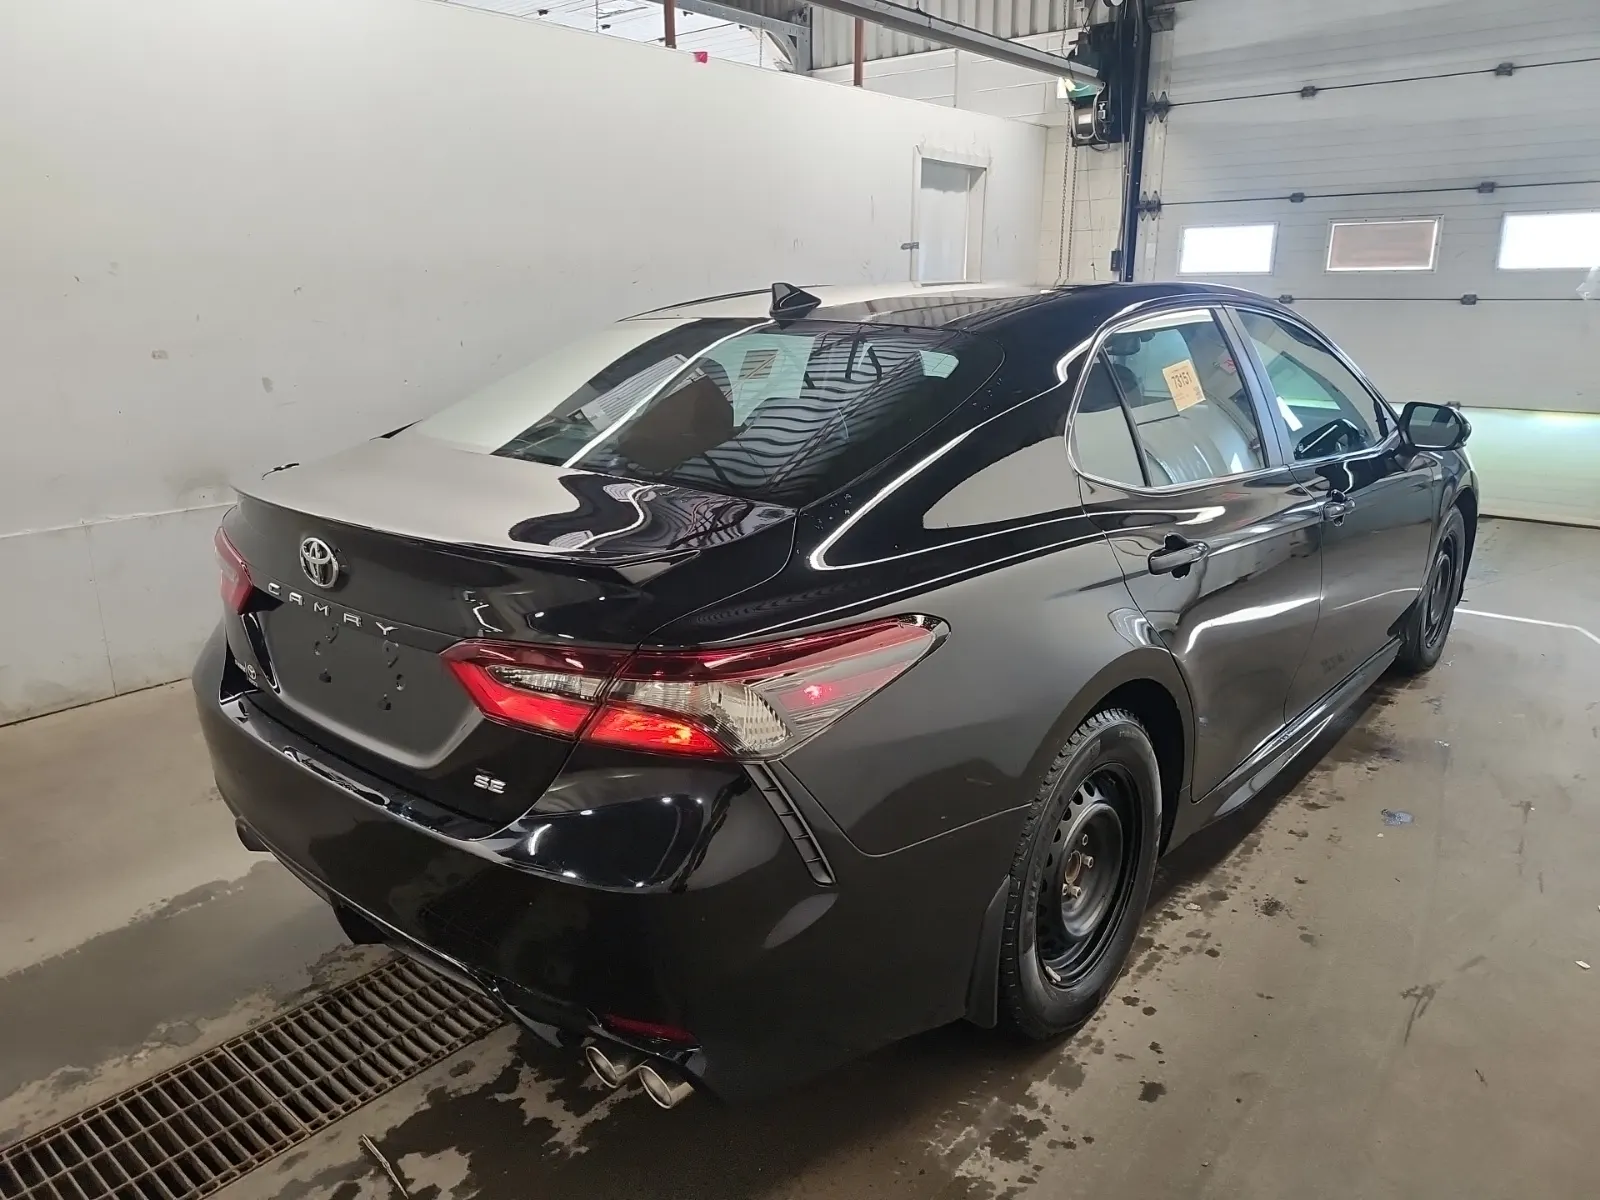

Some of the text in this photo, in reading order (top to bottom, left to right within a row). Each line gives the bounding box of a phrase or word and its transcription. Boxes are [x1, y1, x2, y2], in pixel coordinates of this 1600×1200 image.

[1171, 371, 1193, 389] 73151
[267, 582, 399, 636] CAMRY
[473, 774, 507, 794] SE
